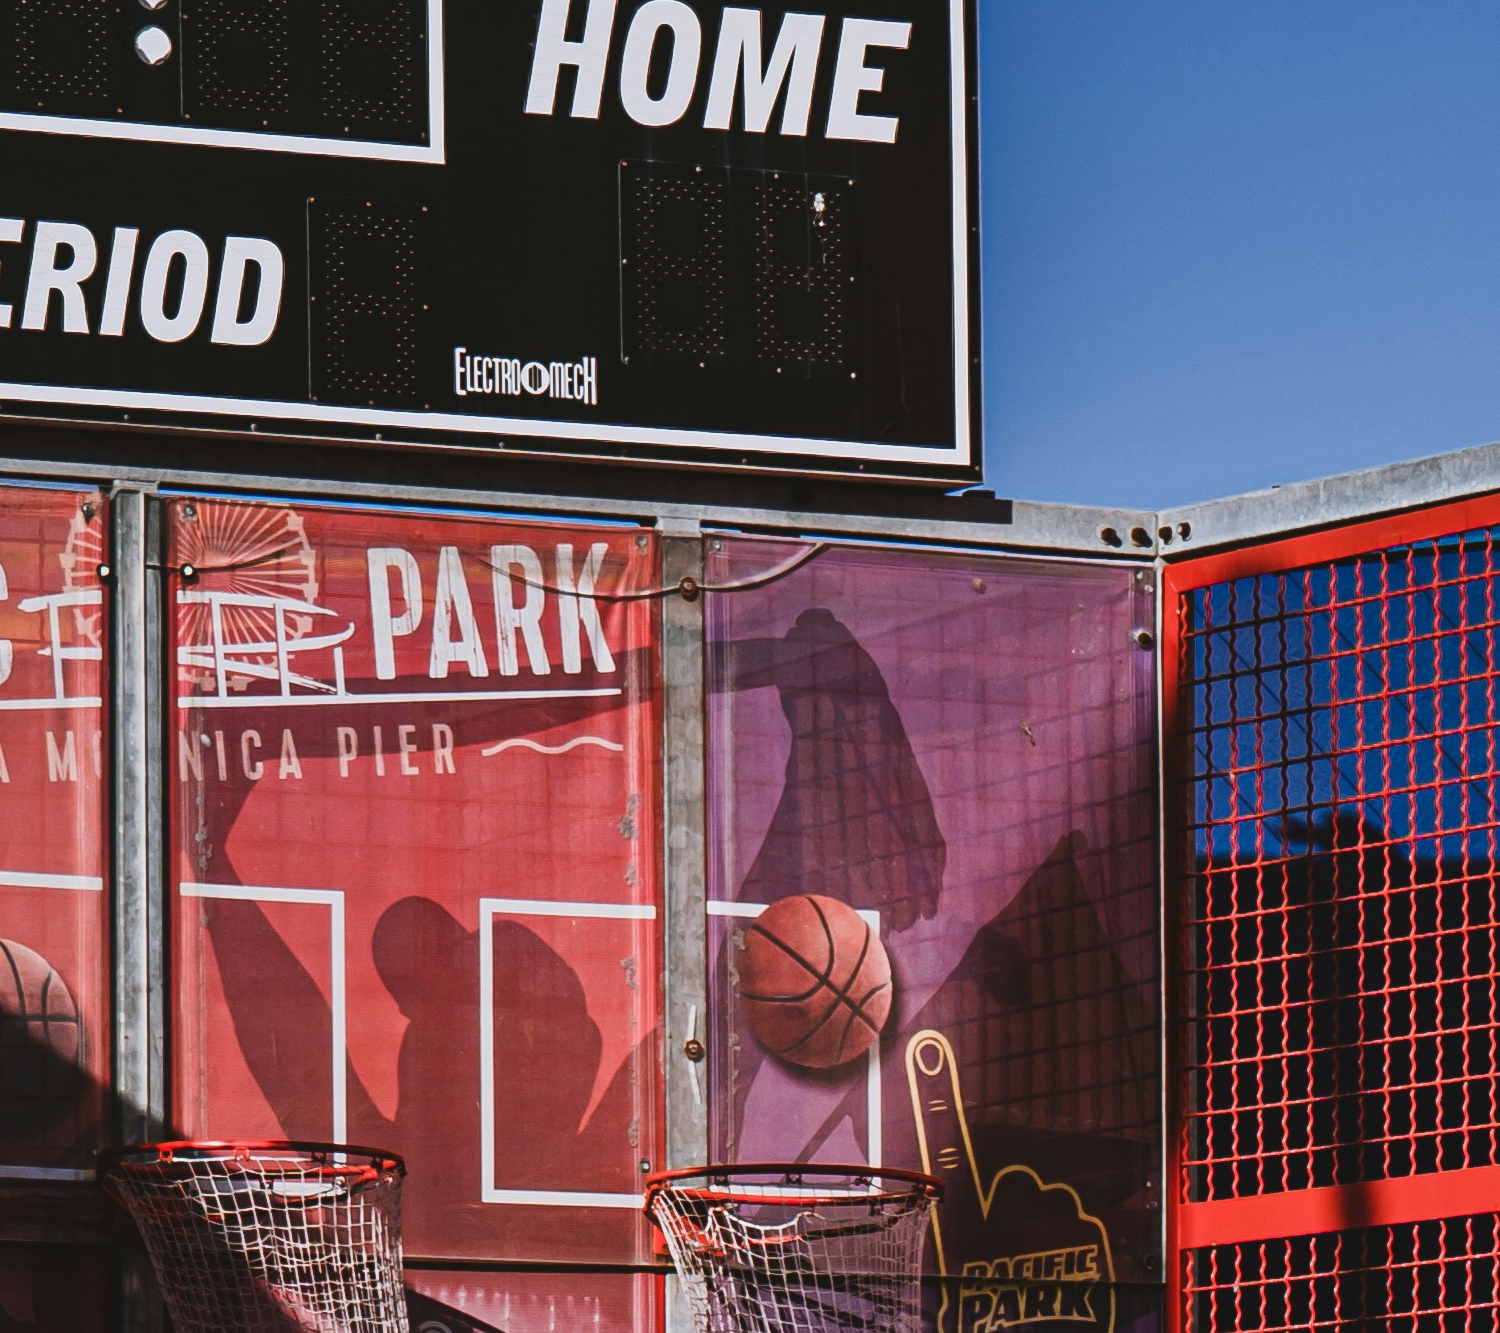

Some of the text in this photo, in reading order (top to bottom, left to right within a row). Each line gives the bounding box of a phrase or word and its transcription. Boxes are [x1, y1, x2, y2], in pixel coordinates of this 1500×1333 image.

[523, 0, 913, 143] HOME
[367, 542, 616, 680] PARK
[46, 722, 303, 784] MNICA
[336, 722, 457, 779] PIER
